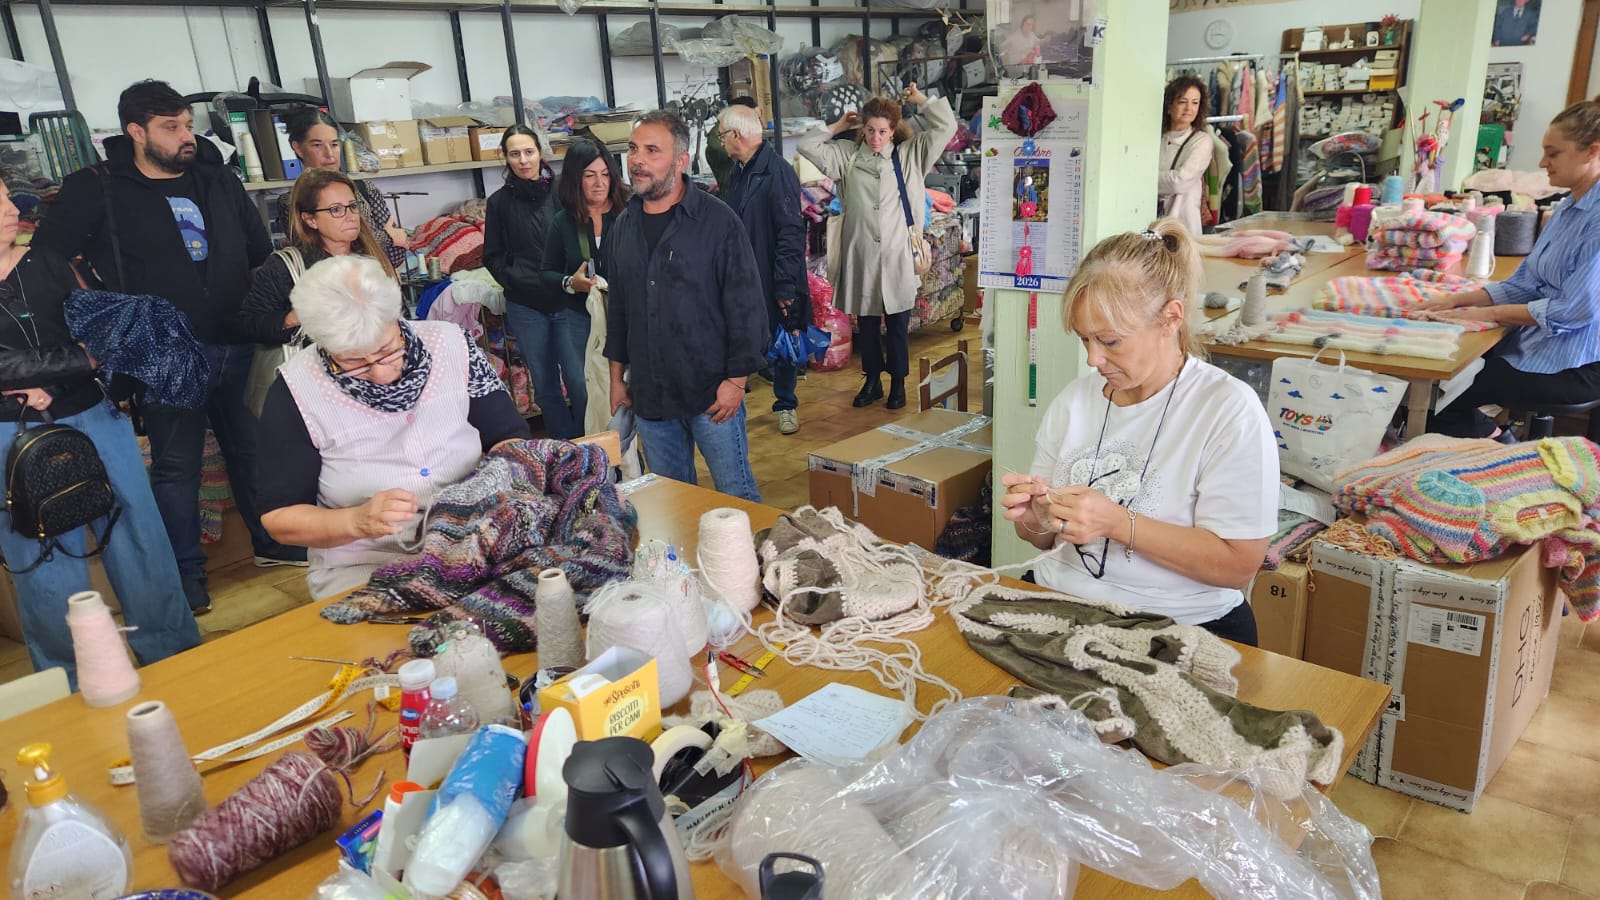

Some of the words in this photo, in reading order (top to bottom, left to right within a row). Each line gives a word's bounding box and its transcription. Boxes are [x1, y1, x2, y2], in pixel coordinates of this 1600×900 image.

[1017, 276, 1039, 287] 2026
[1280, 407, 1314, 426] TOYS
[1270, 585, 1287, 598] 18
[609, 699, 639, 724] BISCOTTI
[610, 720, 624, 737] PER
[624, 709, 641, 727] CANI
